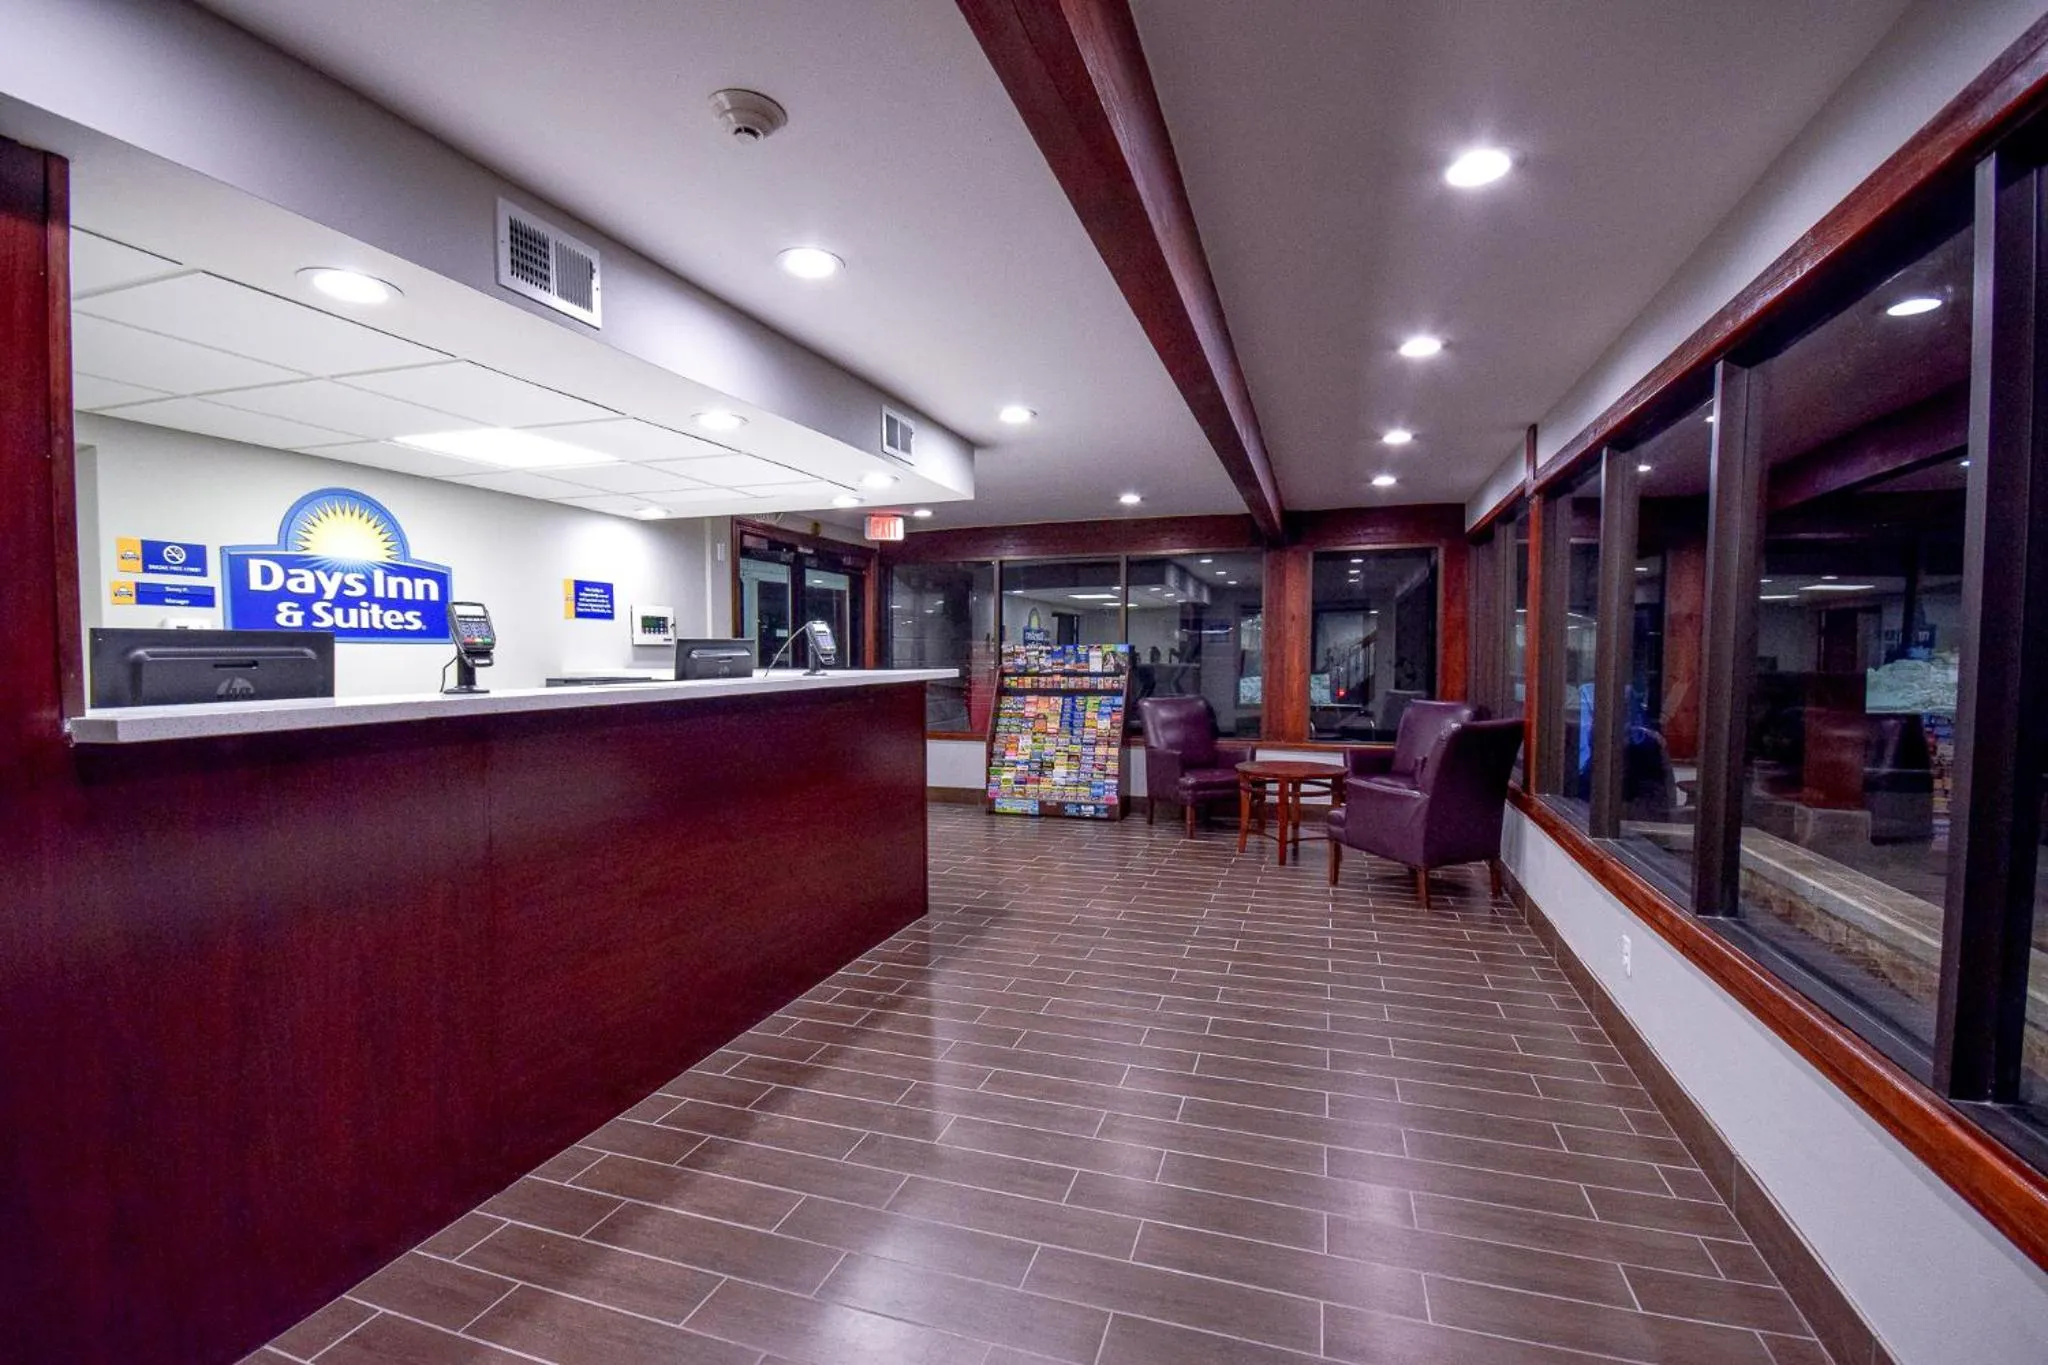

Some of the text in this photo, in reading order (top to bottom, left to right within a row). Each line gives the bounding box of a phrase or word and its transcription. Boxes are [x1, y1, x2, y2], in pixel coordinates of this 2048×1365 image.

[248, 558, 439, 601] Days Inn
[275, 601, 424, 630] & Suites
